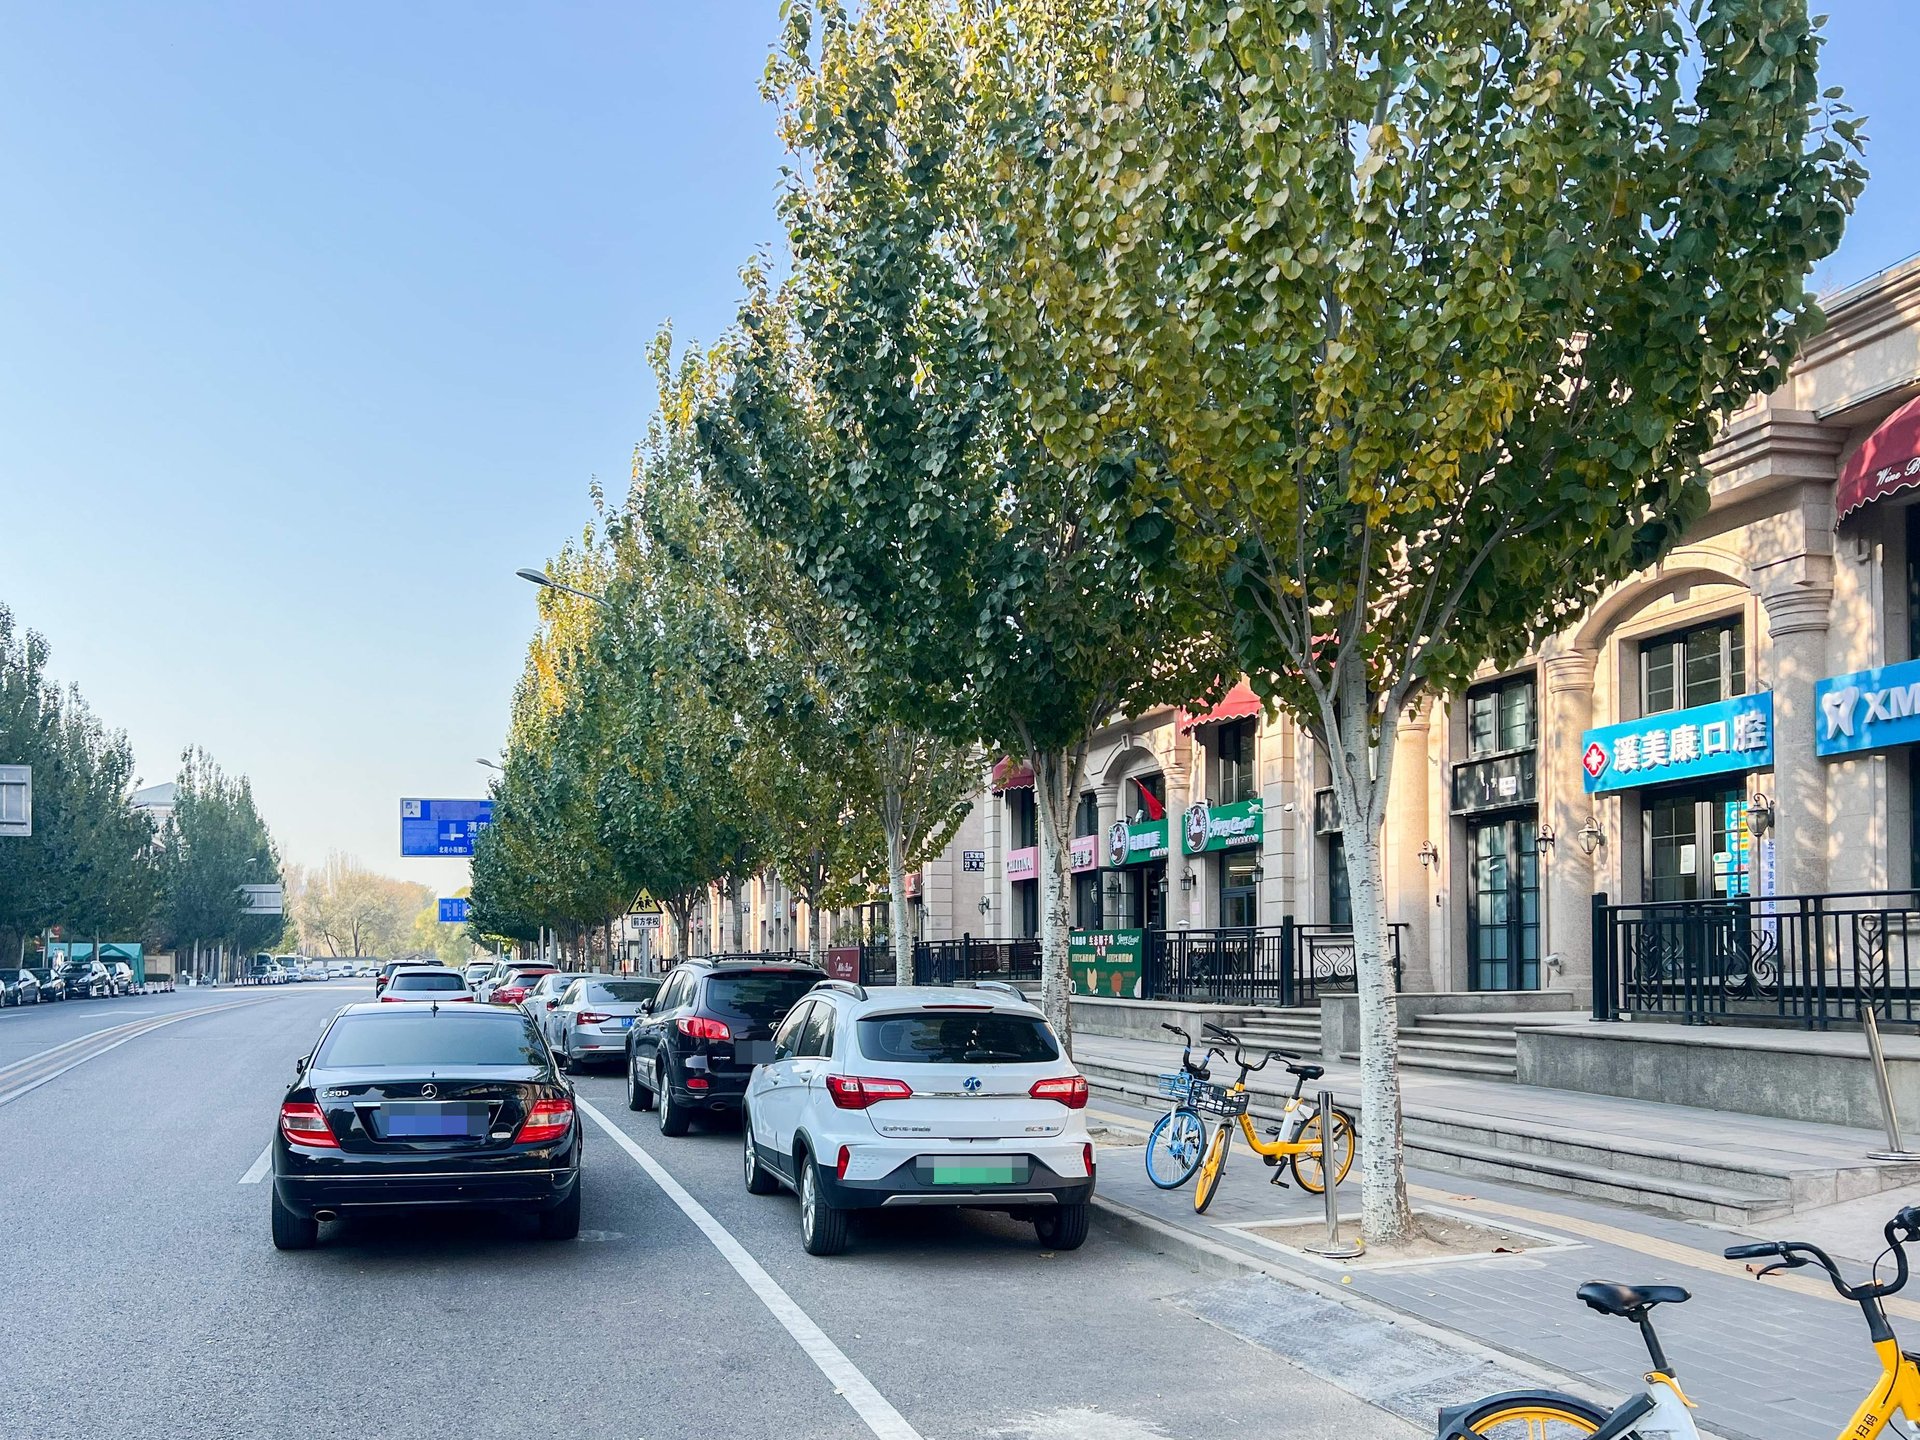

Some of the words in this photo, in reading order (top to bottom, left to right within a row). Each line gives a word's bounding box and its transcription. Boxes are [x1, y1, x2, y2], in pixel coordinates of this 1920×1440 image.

[1613, 709, 1768, 773] 溪美康口腔
[633, 917, 659, 926] 前方学校
